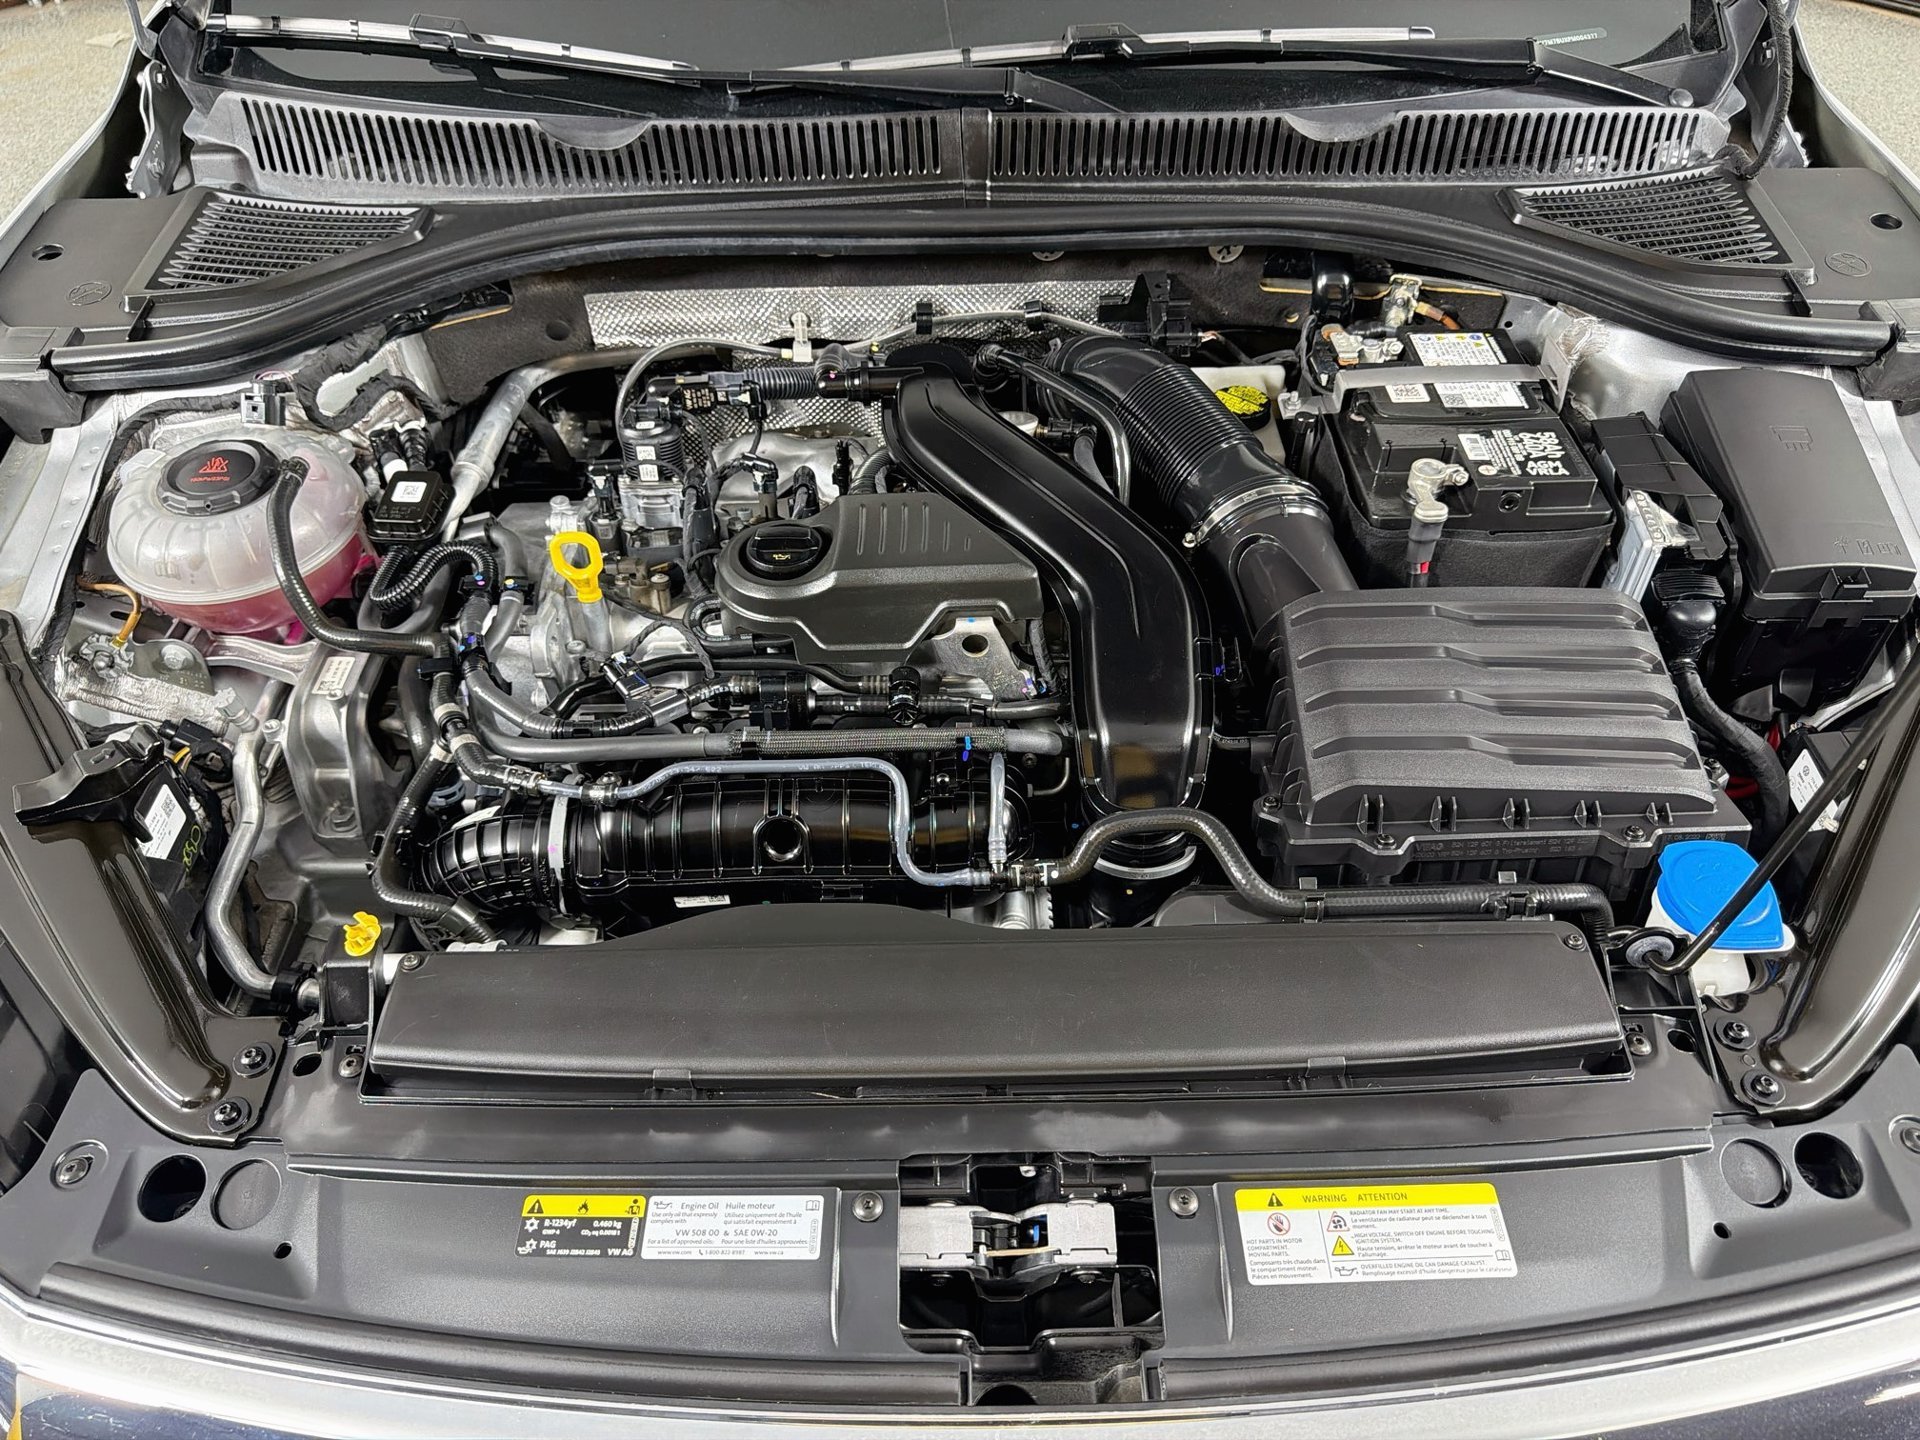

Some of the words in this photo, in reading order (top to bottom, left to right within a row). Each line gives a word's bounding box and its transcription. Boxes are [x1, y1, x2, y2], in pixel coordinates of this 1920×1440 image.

[1542, 431, 1566, 458] 58Ah
[1528, 460, 1564, 468] AGM
[1526, 467, 1570, 476] VRLA
[1302, 1194, 1347, 1203] WARNING
[1358, 1192, 1408, 1202] ATTENTION
[680, 1202, 707, 1211] Engine
[544, 1218, 577, 1229] R-1234yf
[613, 1220, 622, 1228] kg
